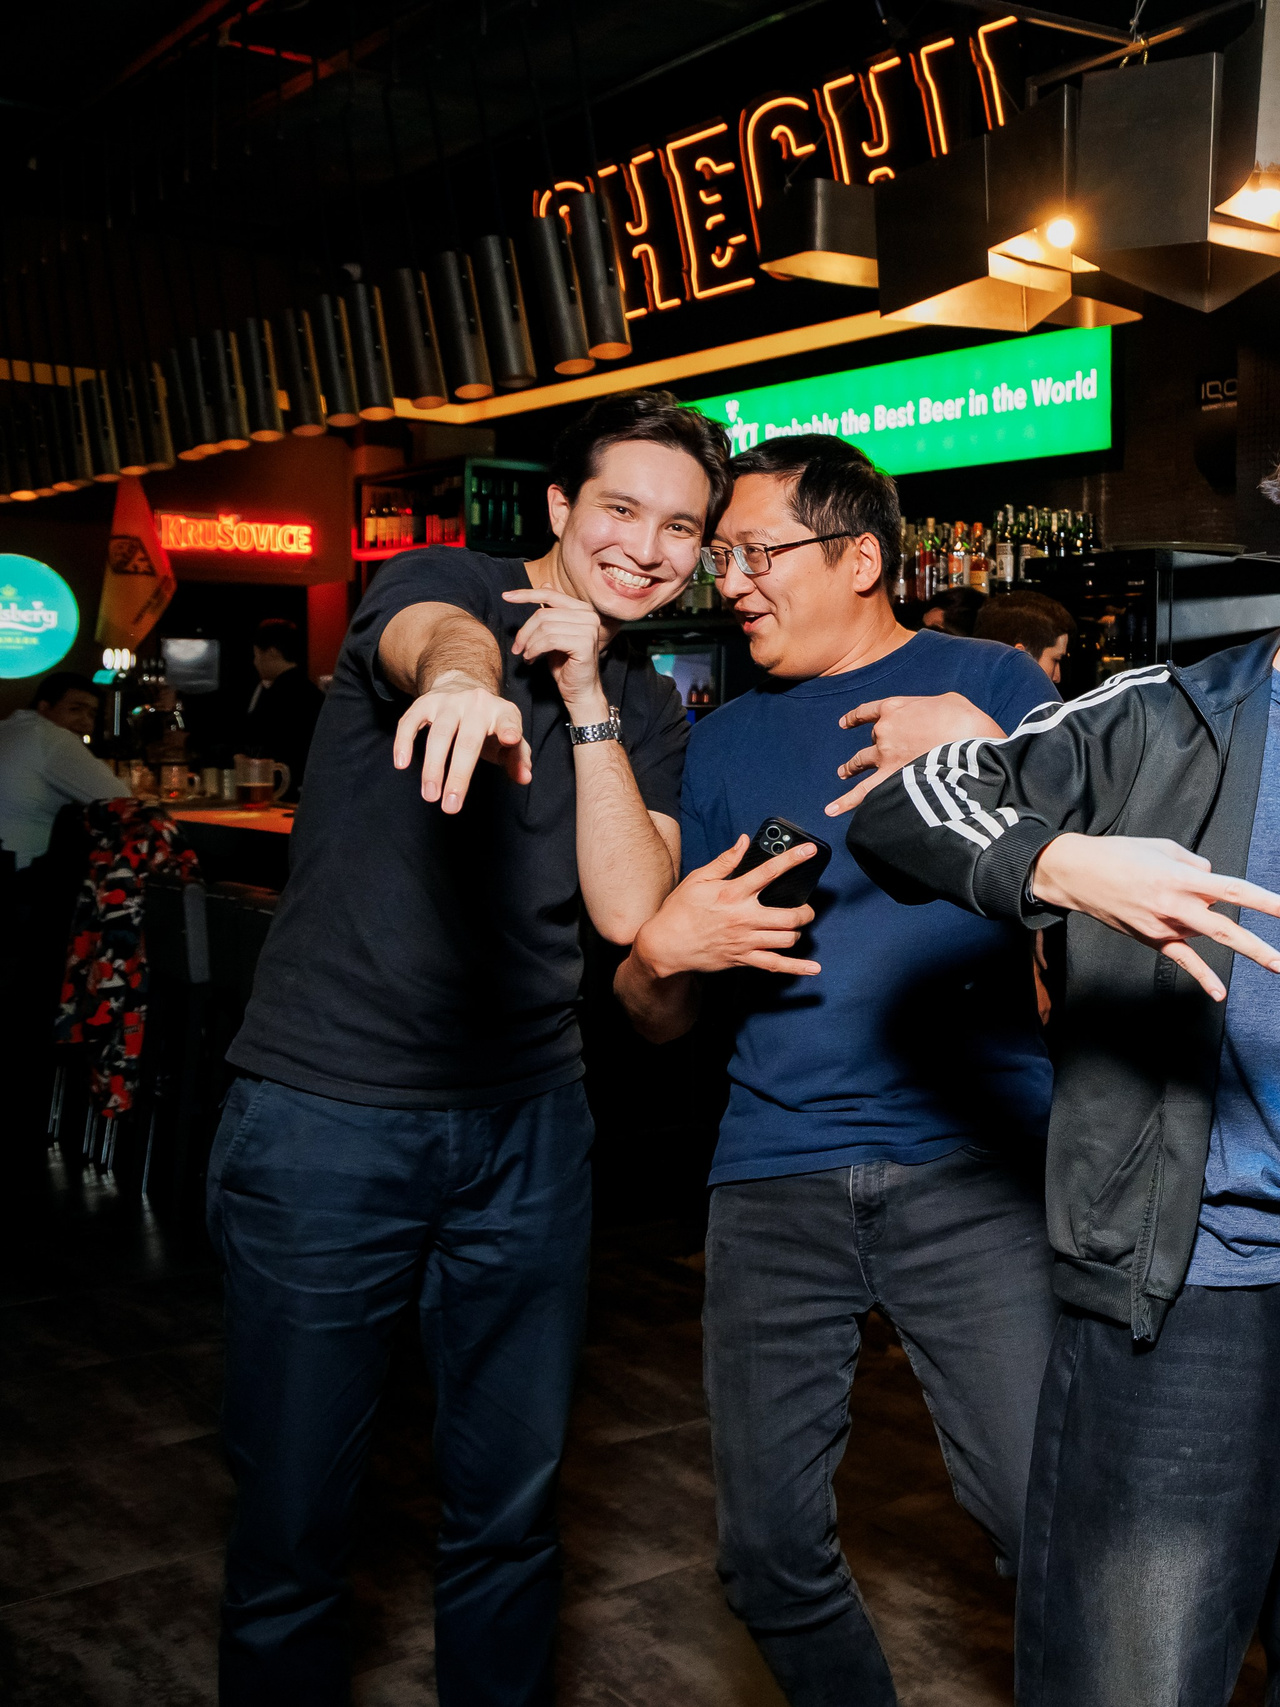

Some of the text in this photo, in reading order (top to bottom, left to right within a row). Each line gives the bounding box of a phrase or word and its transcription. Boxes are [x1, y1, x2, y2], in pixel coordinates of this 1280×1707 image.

[841, 407, 870, 436] the
[874, 399, 915, 431] Best
[918, 397, 966, 425] Beer
[968, 388, 988, 417] in
[991, 382, 1028, 414] the
[1031, 368, 1097, 407] World
[160, 514, 313, 555] KRUŠOVICE
